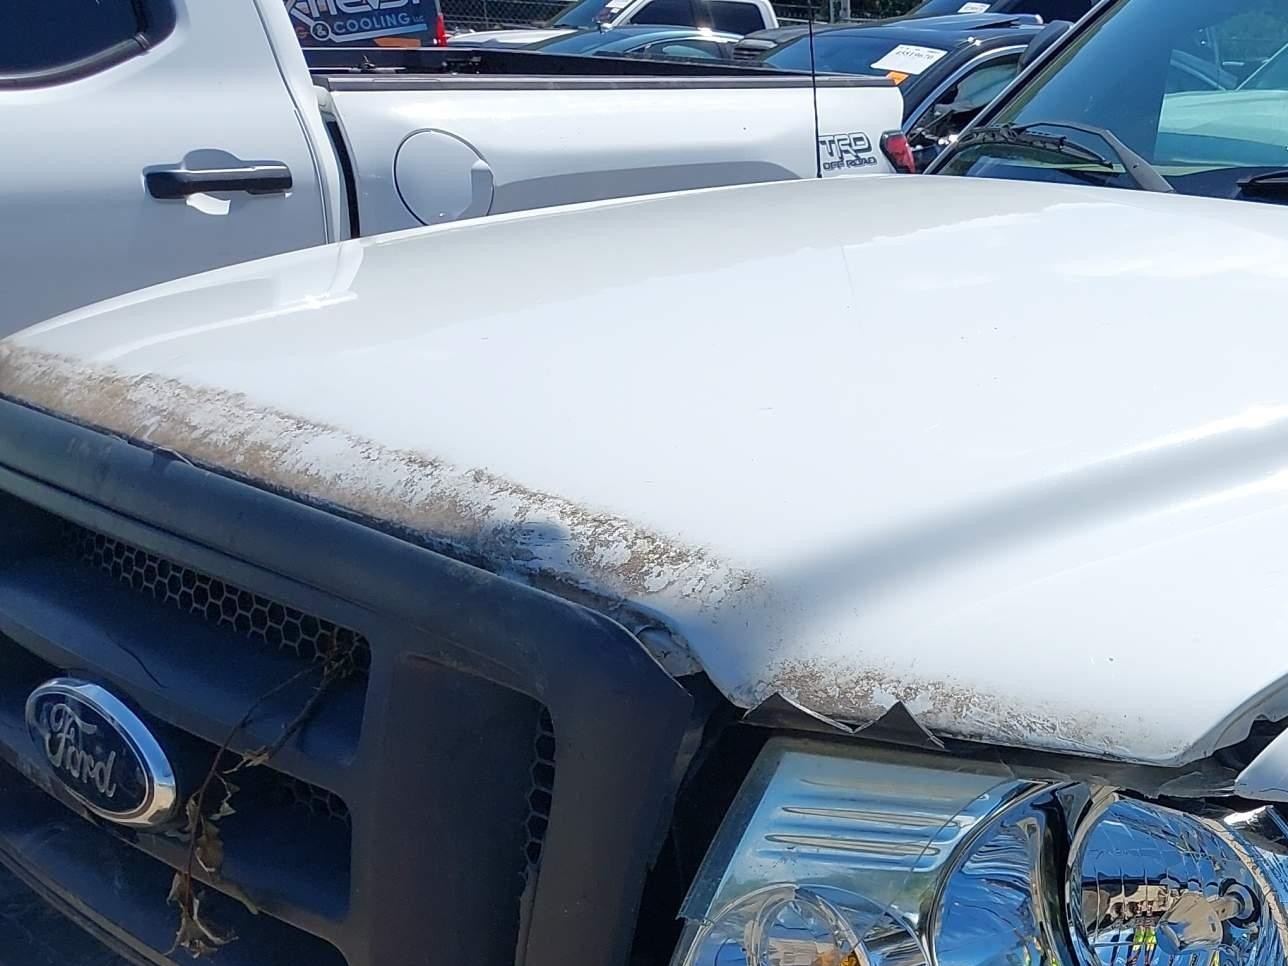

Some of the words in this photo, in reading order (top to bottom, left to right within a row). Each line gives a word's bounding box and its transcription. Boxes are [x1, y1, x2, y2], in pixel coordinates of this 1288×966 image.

[333, 12, 410, 34] COOLING
[819, 132, 873, 161] TRD
[823, 161, 845, 171] OFF
[846, 156, 878, 168] ROAD
[45, 703, 117, 798] Ford
